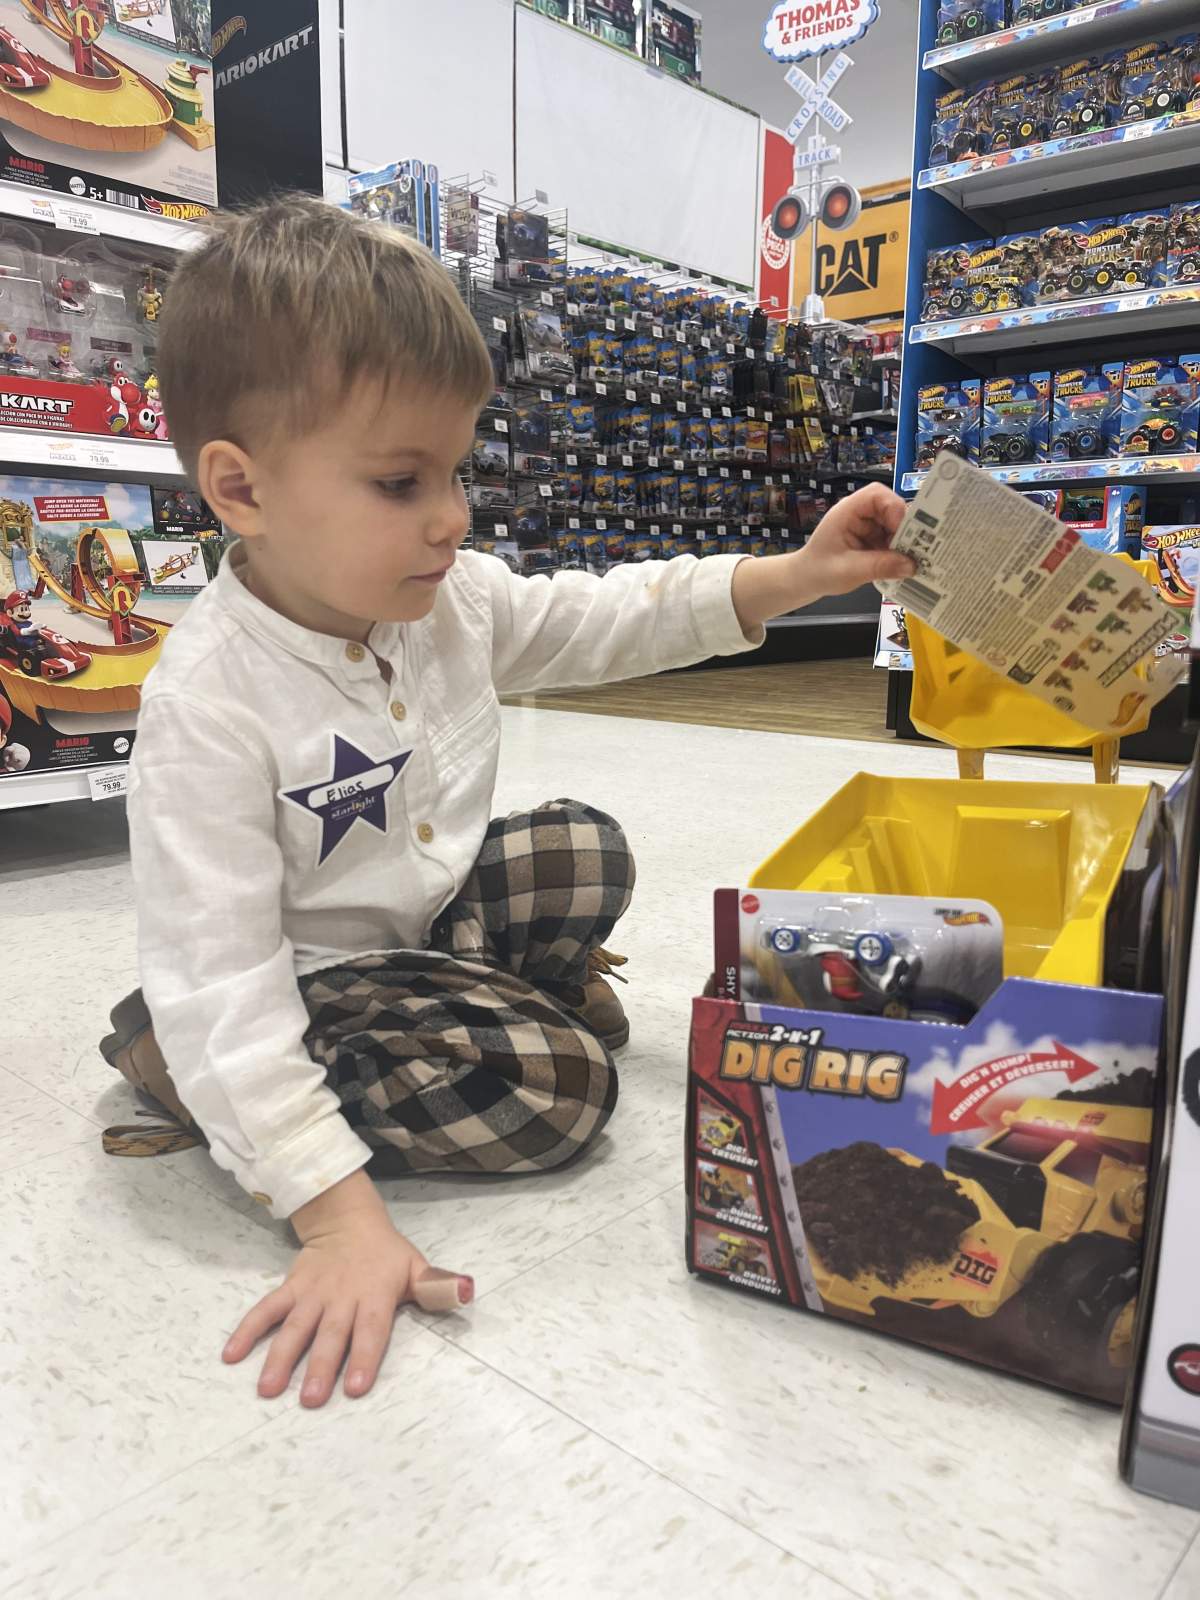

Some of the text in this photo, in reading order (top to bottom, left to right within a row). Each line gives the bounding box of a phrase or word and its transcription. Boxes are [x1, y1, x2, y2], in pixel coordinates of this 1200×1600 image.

[776, 0, 860, 31] THOMAS
[781, 14, 854, 45] & FRIENDS
[214, 25, 313, 90] ARIOKART
[1125, 64, 1156, 77] TRUCKS
[786, 69, 811, 100] RAIL
[819, 99, 845, 131] ROAD
[797, 149, 832, 167] TRACK
[89, 186, 104, 200] 5+
[1085, 244, 1120, 254] MONSTER
[815, 233, 887, 298] CAT
[1056, 386, 1084, 397] TRUCKS
[1126, 377, 1157, 389] TRUCKS
[0, 391, 74, 415] KART
[920, 400, 945, 411] TRUCKS
[987, 394, 1013, 404] TRUCKS
[1158, 533, 1176, 549] HOT
[1174, 527, 1200, 545] WHEE
[102, 781, 121, 792] 79.99
[326, 781, 365, 804] Elias
[331, 796, 375, 819] starlight
[726, 966, 736, 995] SHY
[721, 1039, 906, 1101] DIG RIG
[990, 1054, 1032, 1073] DUMP!
[948, 1084, 991, 1122] CREUSER
[989, 1076, 1004, 1089] ET
[712, 1148, 759, 1168] CREUSER!
[730, 1206, 763, 1223] DUMP!
[743, 1270, 777, 1286] DRIVE!
[954, 1254, 998, 1286] DIG
[728, 1274, 782, 1296] CONDUIRE!
